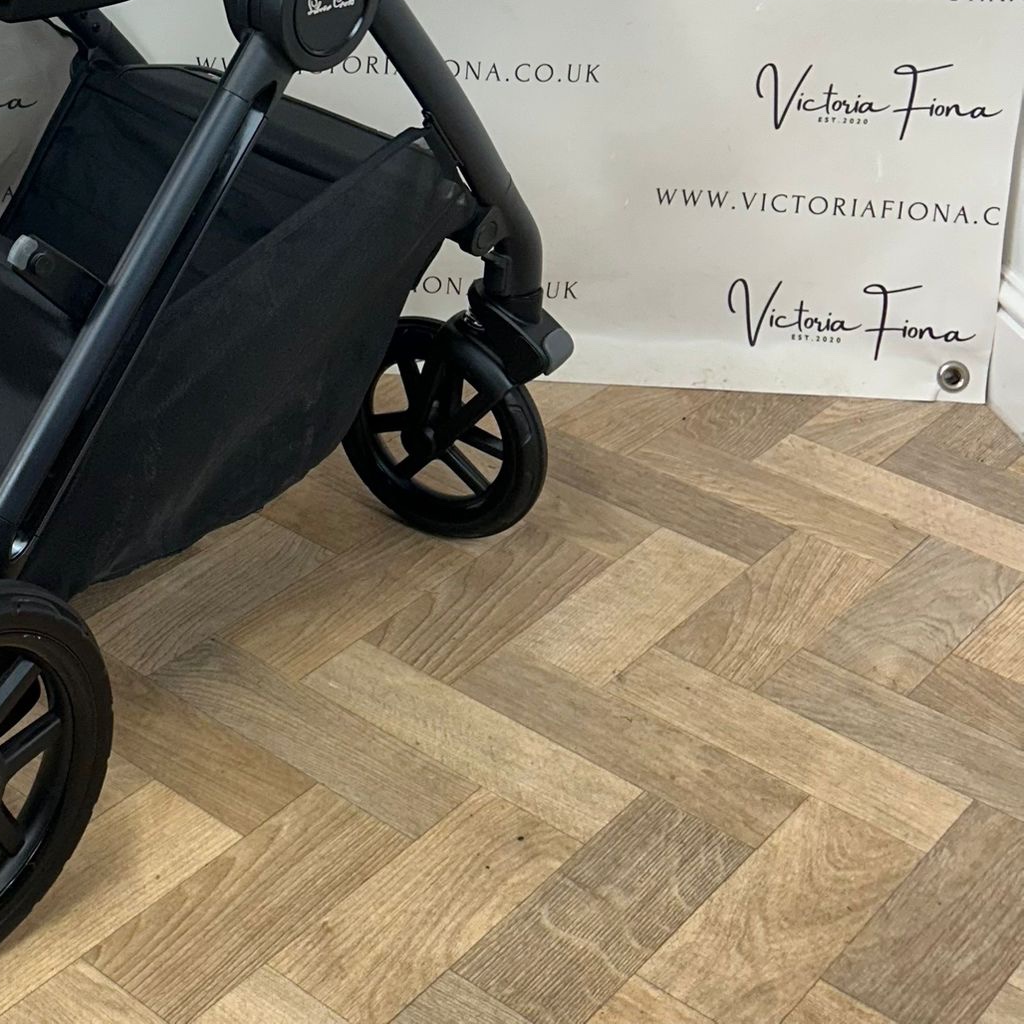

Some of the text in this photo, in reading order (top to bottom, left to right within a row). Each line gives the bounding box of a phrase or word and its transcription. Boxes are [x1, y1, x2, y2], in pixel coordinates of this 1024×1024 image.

[755, 62, 1004, 141] Victoria Fiona
[817, 116, 869, 125] EST.2020
[727, 277, 977, 362] Victoria Fiona
[791, 333, 842, 344] EST.2020
